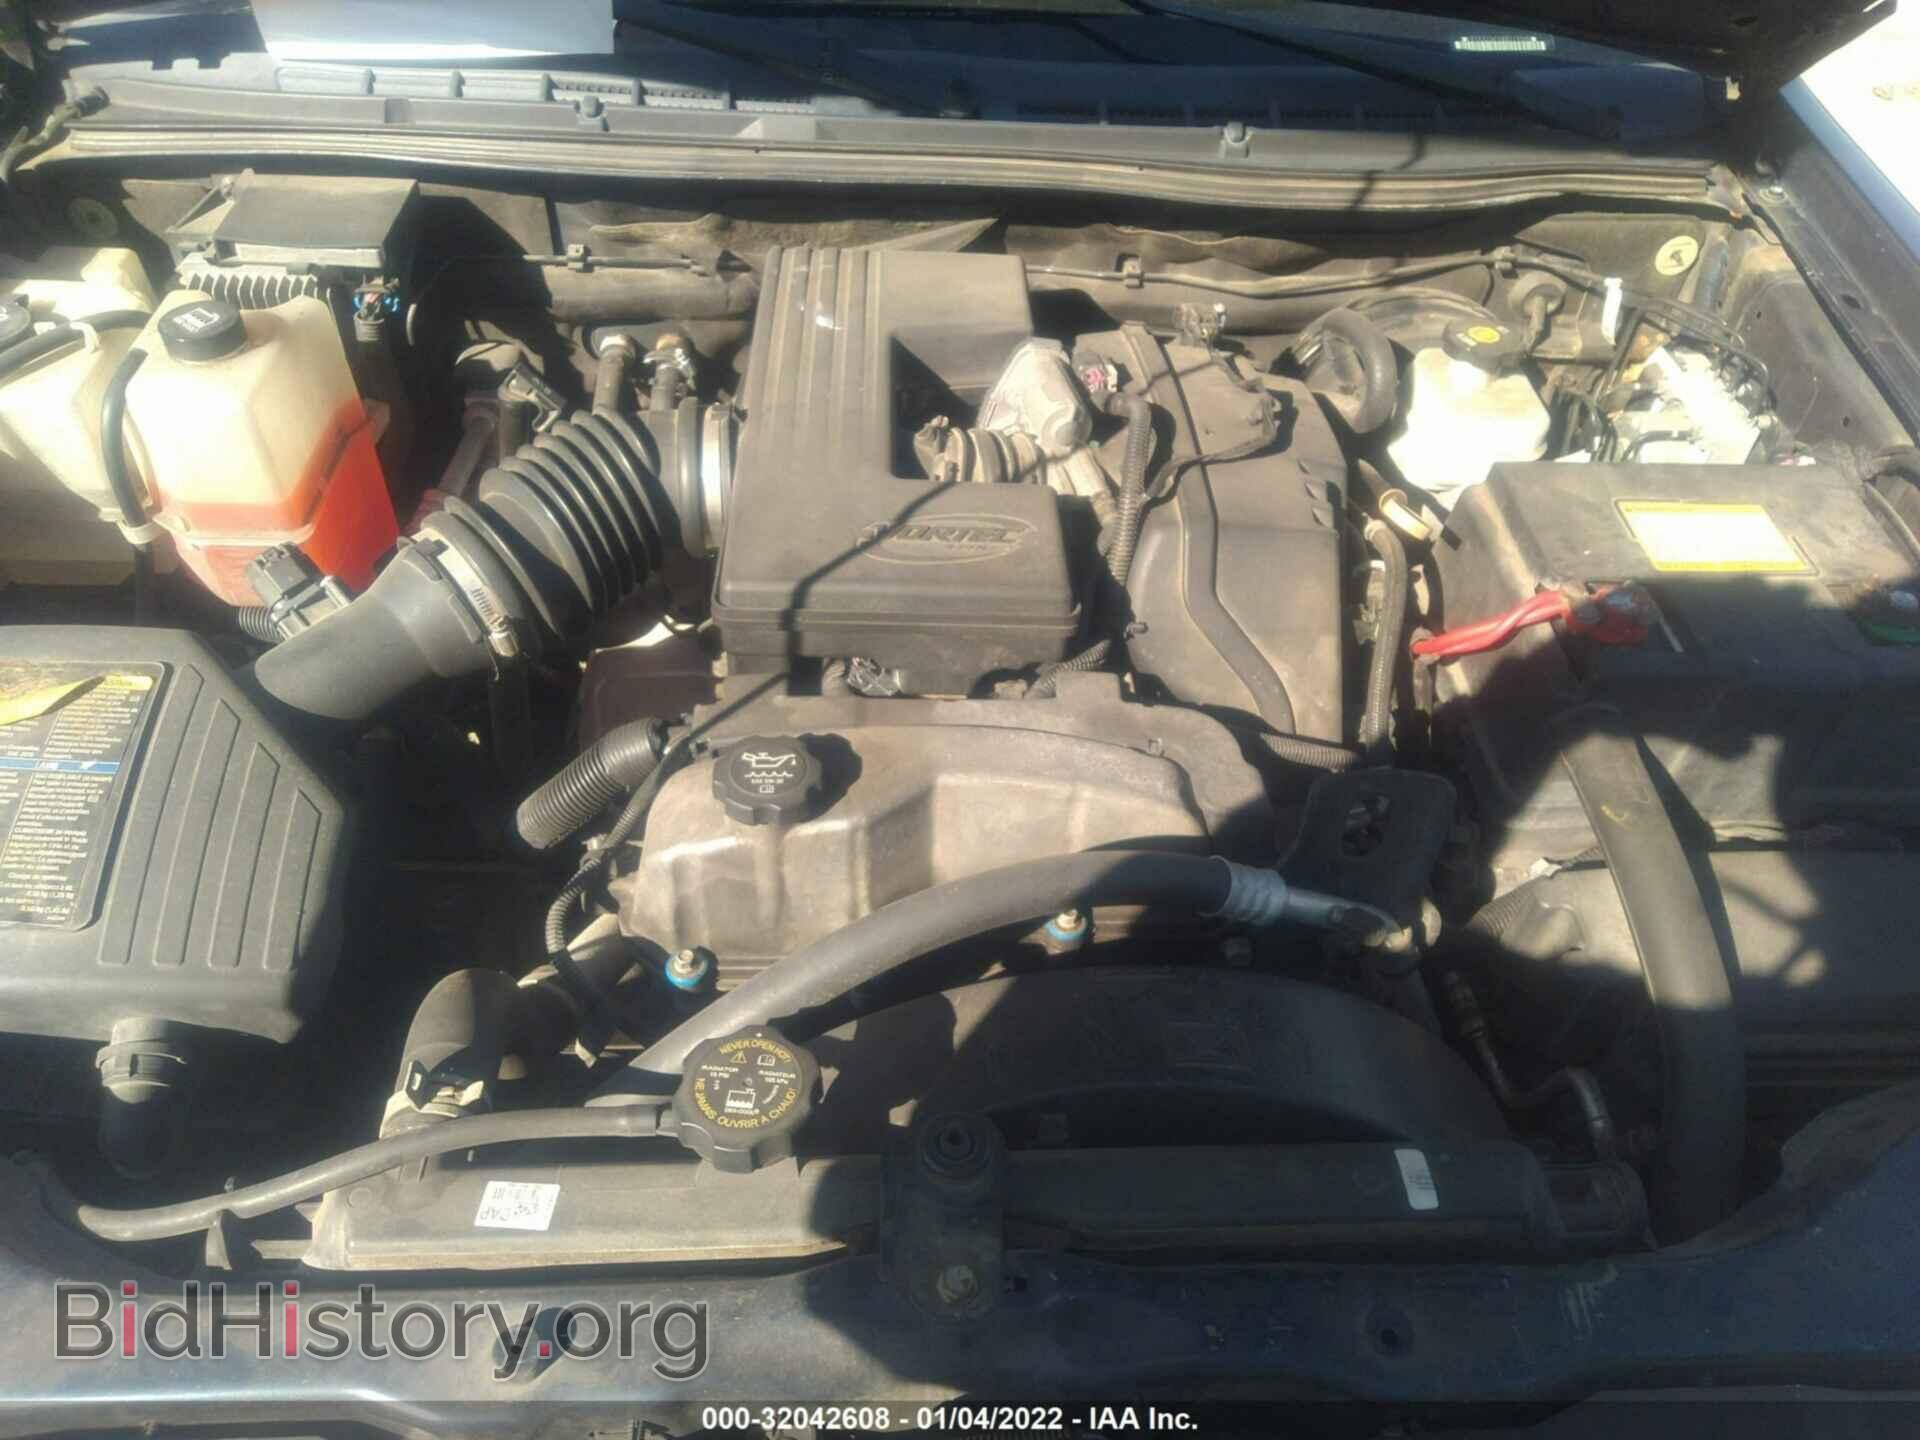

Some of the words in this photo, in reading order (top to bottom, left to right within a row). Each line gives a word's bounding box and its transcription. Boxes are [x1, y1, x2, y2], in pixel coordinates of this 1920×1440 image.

[719, 1039, 751, 1054] NEVER
[751, 1039, 777, 1054] OPEN
[718, 1115, 760, 1129] OUVRIR
